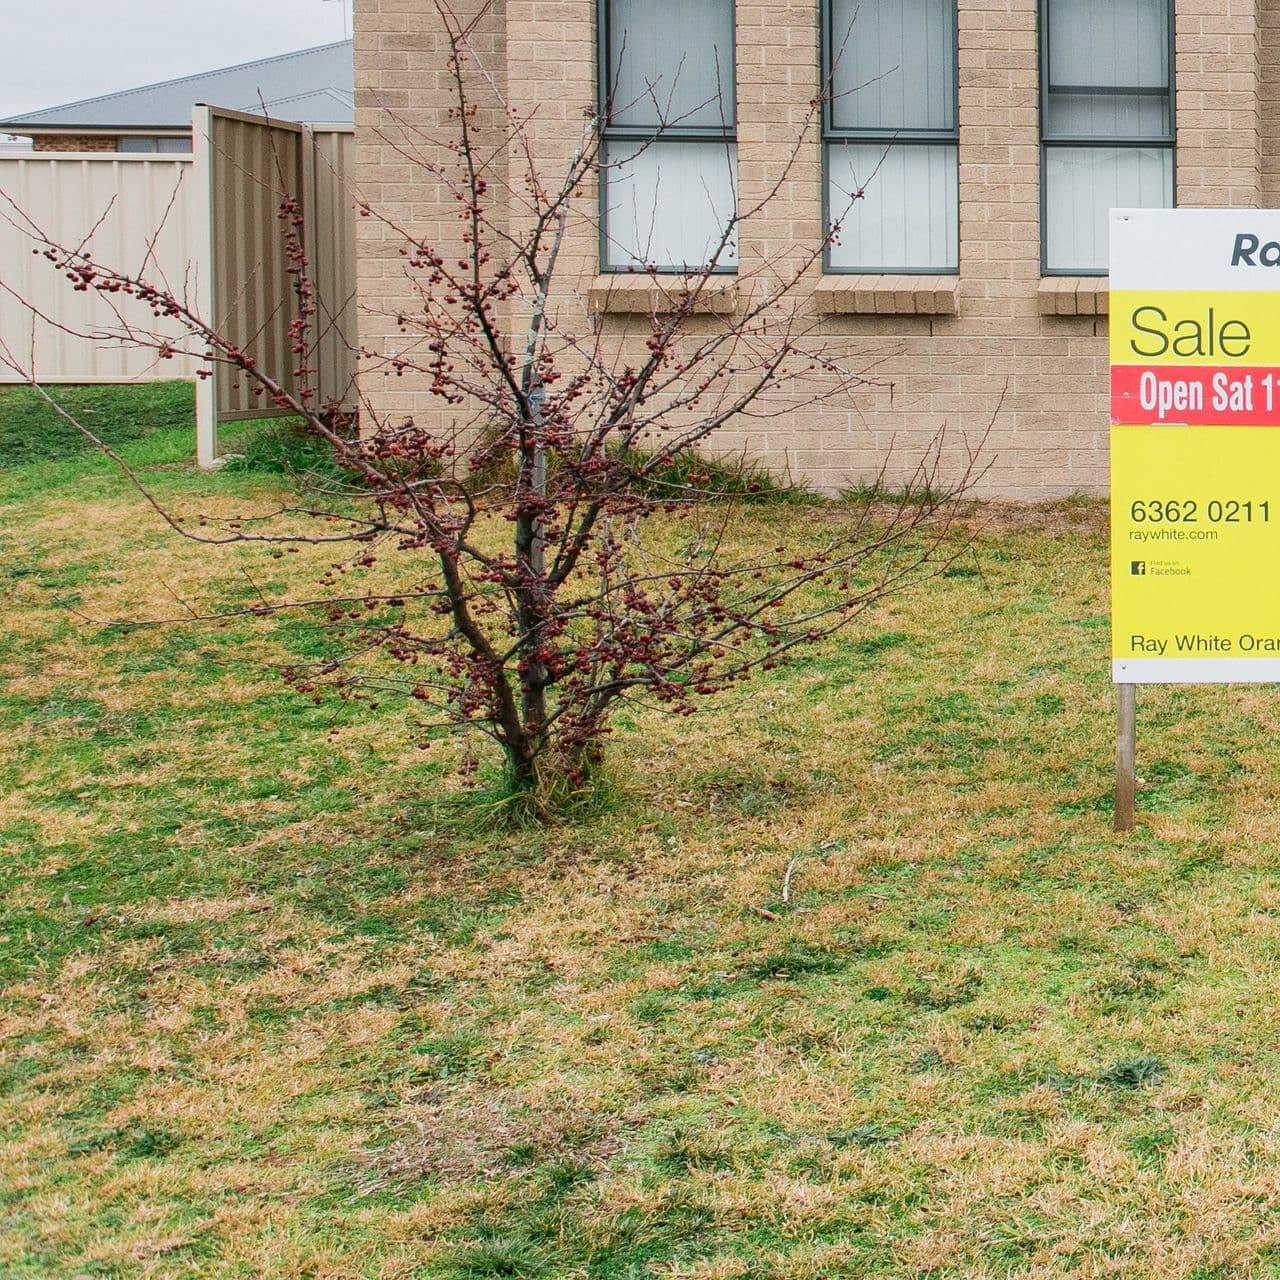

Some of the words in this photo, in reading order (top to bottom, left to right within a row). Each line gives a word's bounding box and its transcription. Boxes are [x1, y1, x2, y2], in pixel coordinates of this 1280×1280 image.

[1130, 306, 1251, 358] Sale
[1139, 371, 1203, 418] Open
[1212, 373, 1253, 412] Sat
[1130, 500, 1198, 523] 6362
[1207, 500, 1269, 523] 0211
[1129, 529, 1219, 542] raywhite.com
[1150, 567, 1192, 576] Facebook
[1131, 635, 1169, 655] Ray
[1174, 634, 1232, 652] White
